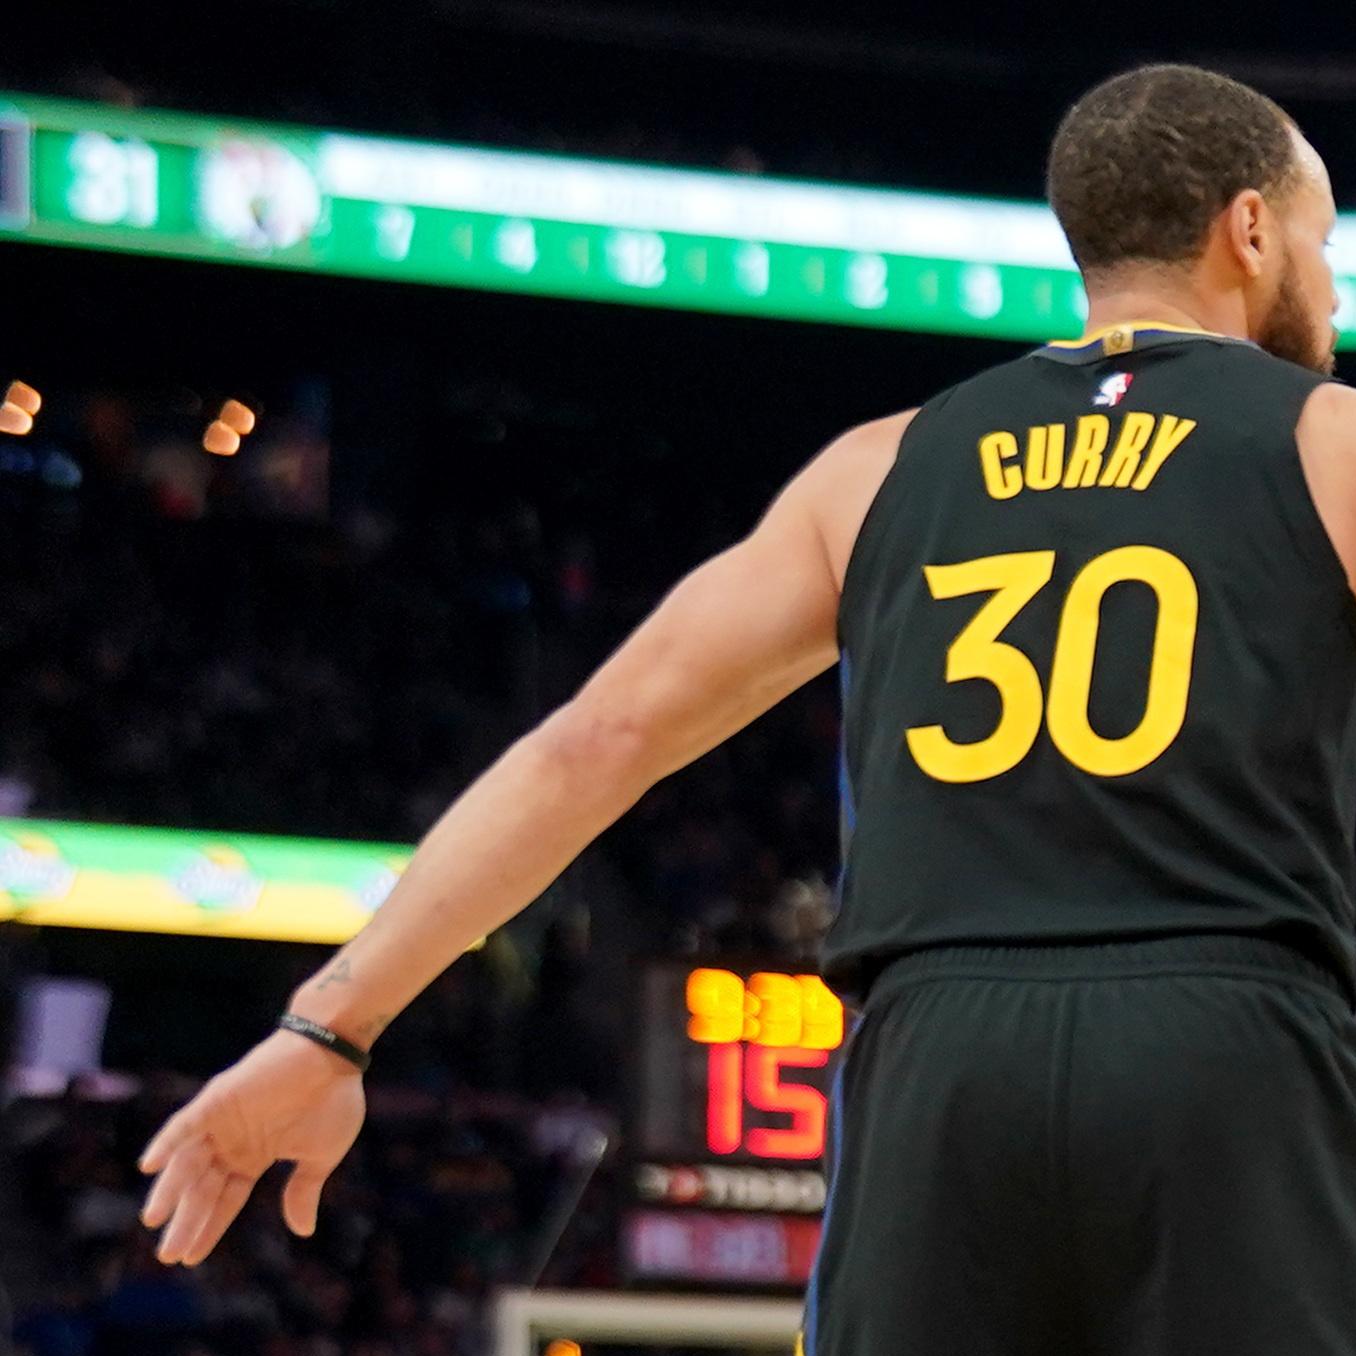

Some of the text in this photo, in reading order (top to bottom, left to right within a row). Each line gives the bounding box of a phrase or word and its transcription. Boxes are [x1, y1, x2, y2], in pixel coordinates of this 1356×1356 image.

[978, 412, 1198, 500] CURRY
[905, 545, 1199, 784] 30
[706, 1043, 828, 1160] 15
